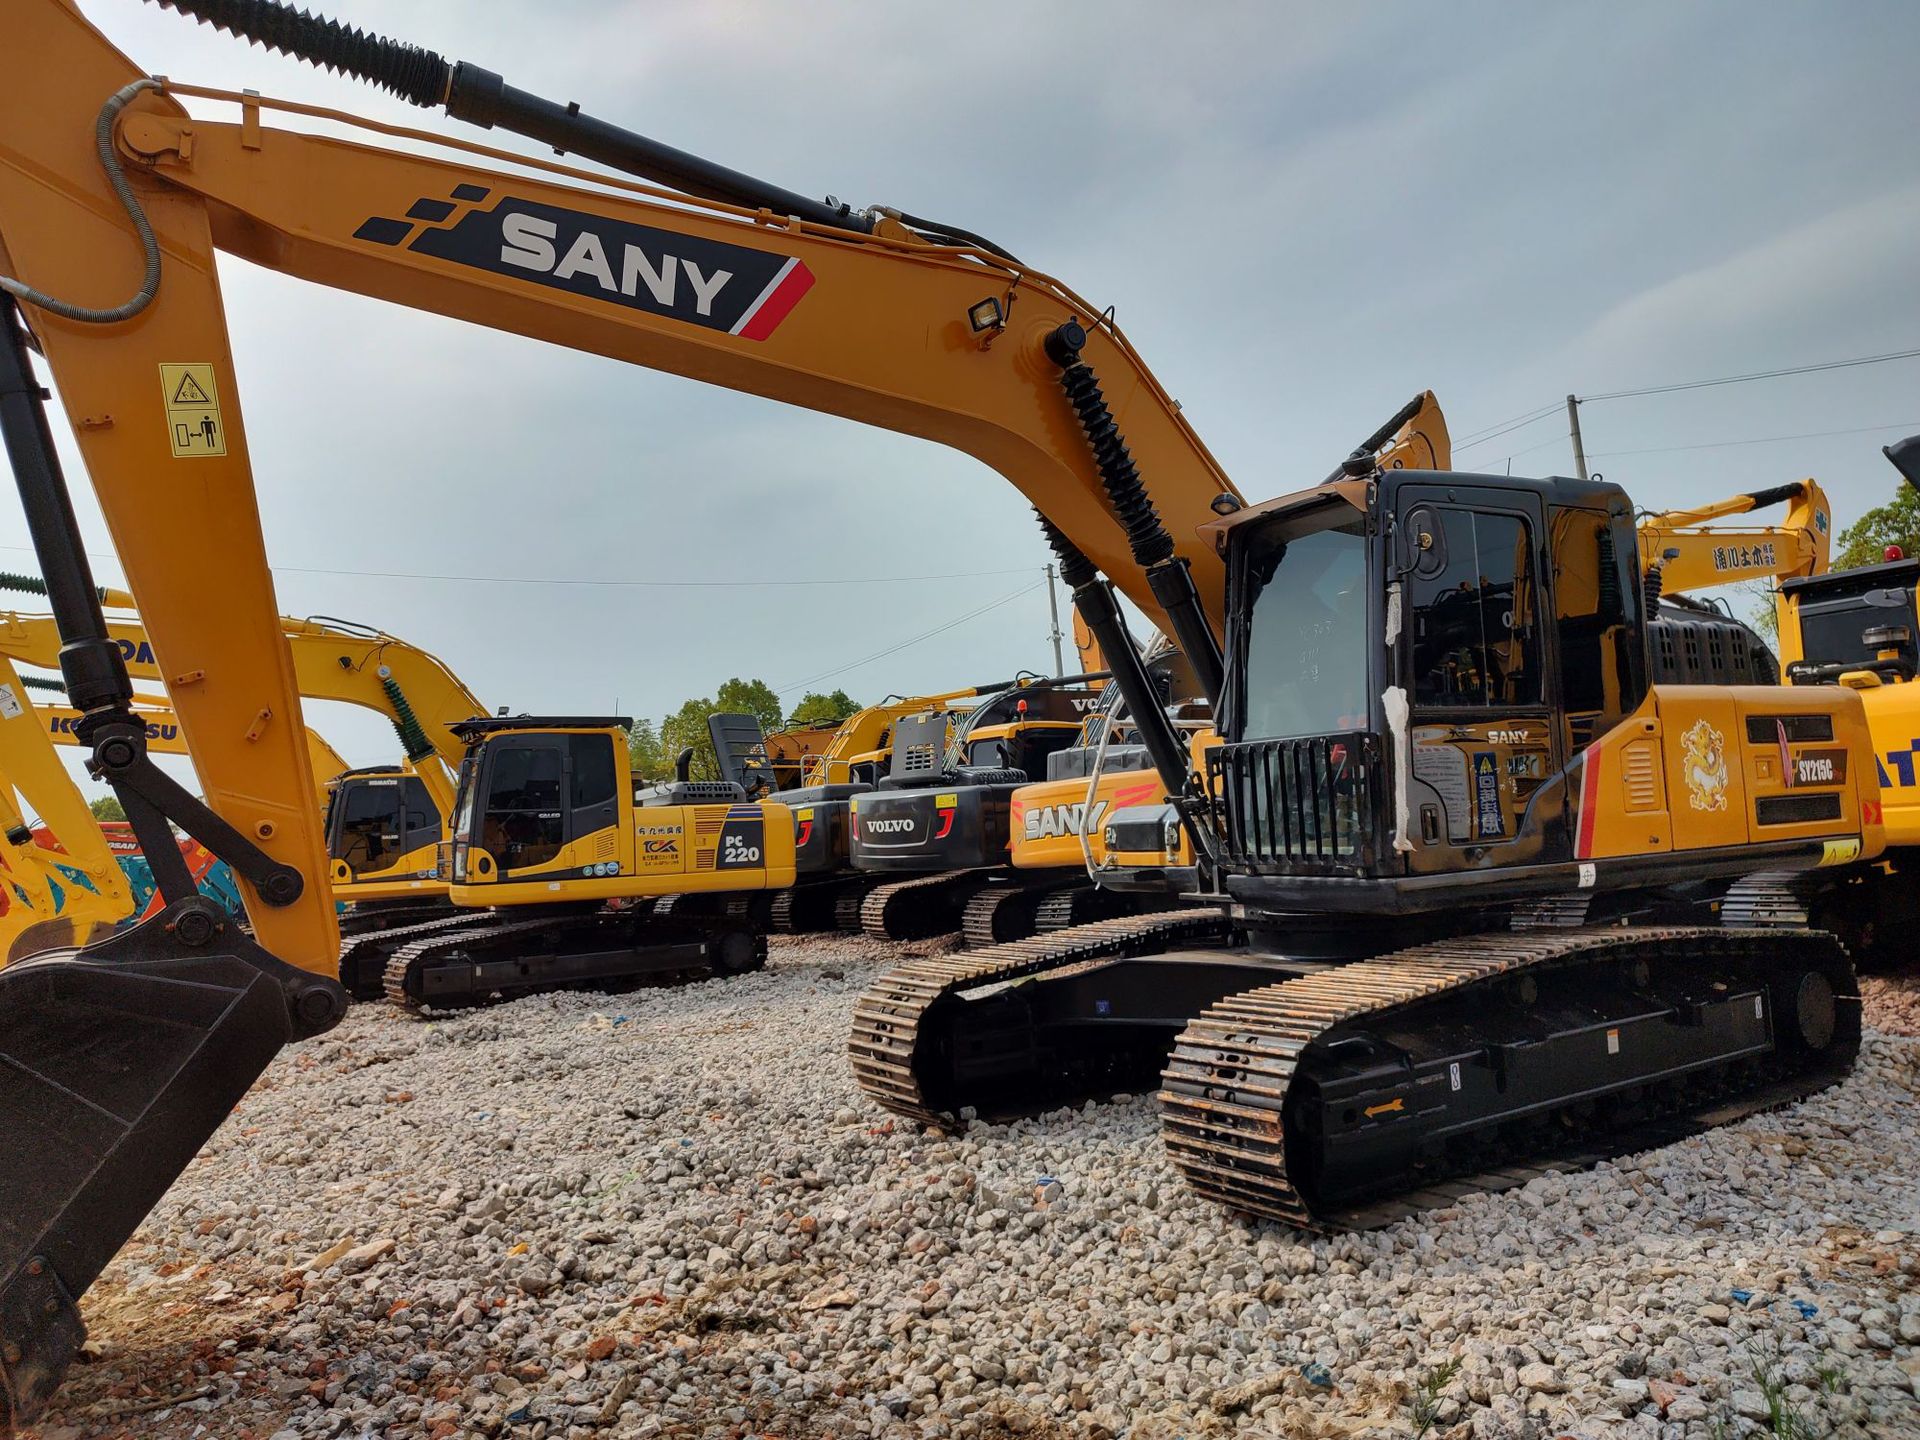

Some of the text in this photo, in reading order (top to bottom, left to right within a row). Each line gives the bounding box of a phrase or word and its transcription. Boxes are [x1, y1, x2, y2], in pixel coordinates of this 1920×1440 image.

[500, 212, 734, 317] SANY
[1487, 731, 1529, 744] SANY
[1798, 758, 1834, 782] SY215C
[867, 819, 915, 833] VOLVO
[1024, 801, 1109, 841] SANY
[725, 835, 743, 848] PC
[724, 847, 760, 863] 220
